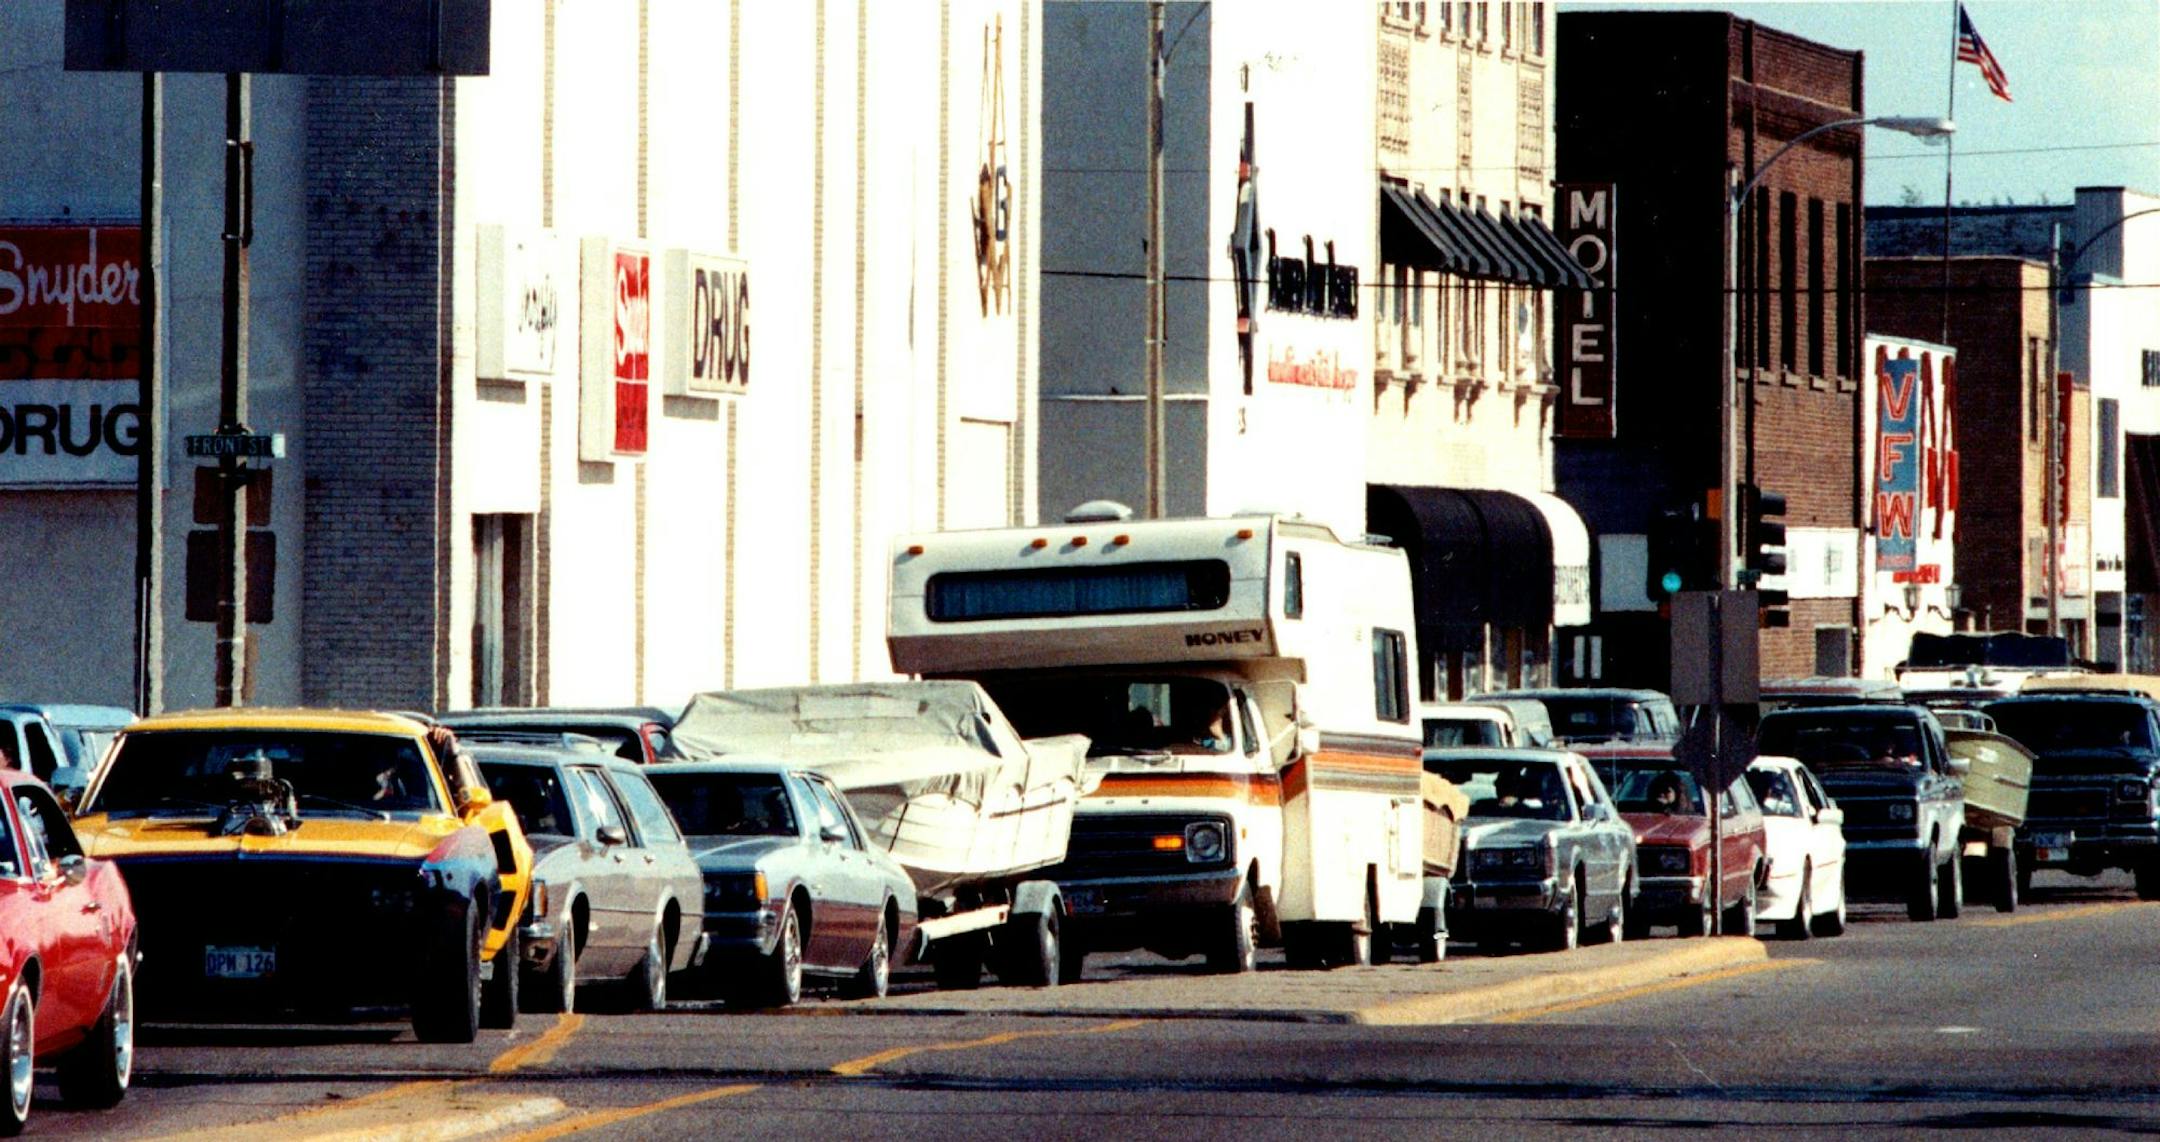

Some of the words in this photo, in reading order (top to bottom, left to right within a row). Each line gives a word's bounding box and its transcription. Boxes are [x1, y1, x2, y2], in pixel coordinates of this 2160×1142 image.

[694, 268, 749, 387] DRUG
[193, 437, 244, 454] FRONT
[248, 437, 267, 454] ST
[1185, 628, 1263, 647] HONEY
[246, 952, 275, 972] 126
